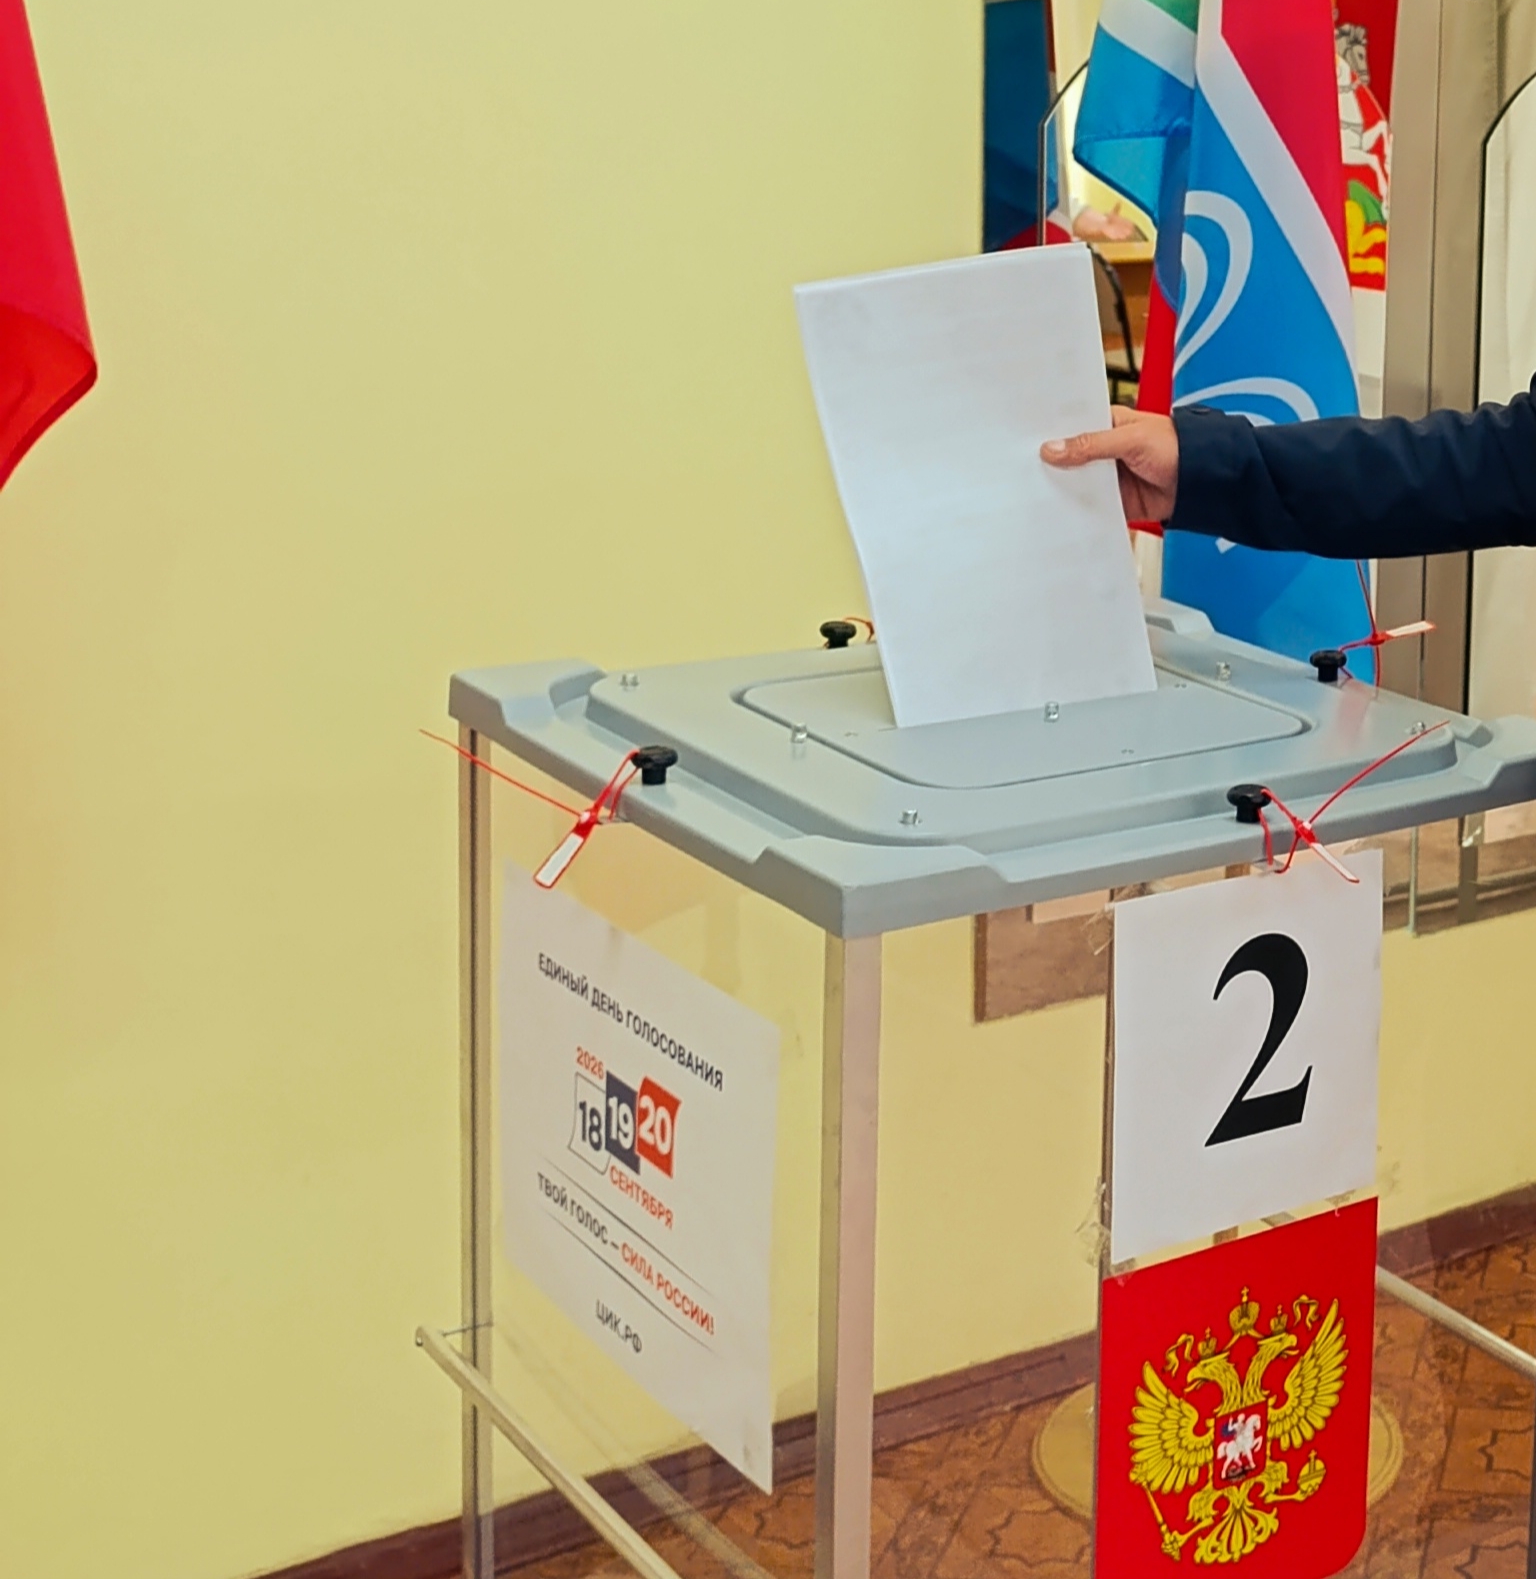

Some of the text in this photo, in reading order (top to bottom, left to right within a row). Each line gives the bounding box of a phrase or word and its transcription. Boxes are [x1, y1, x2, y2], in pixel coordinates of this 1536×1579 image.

[538, 952, 724, 1092] ЕДИНЫЙ ДЕНЬ ГОЛОСОВАНИЯ
[1204, 932, 1313, 1147] 2
[576, 1046, 604, 1080] 2026
[578, 1095, 673, 1155] 18 19 20
[610, 1165, 674, 1230] СЕНТЯБРЯ
[537, 1172, 568, 1211] ТВОЙ
[570, 1200, 608, 1245] ГОЛОС
[621, 1242, 654, 1285] СИЛА
[656, 1272, 715, 1336] РОССИИ!
[596, 1299, 642, 1353] ЦИК.РФ
